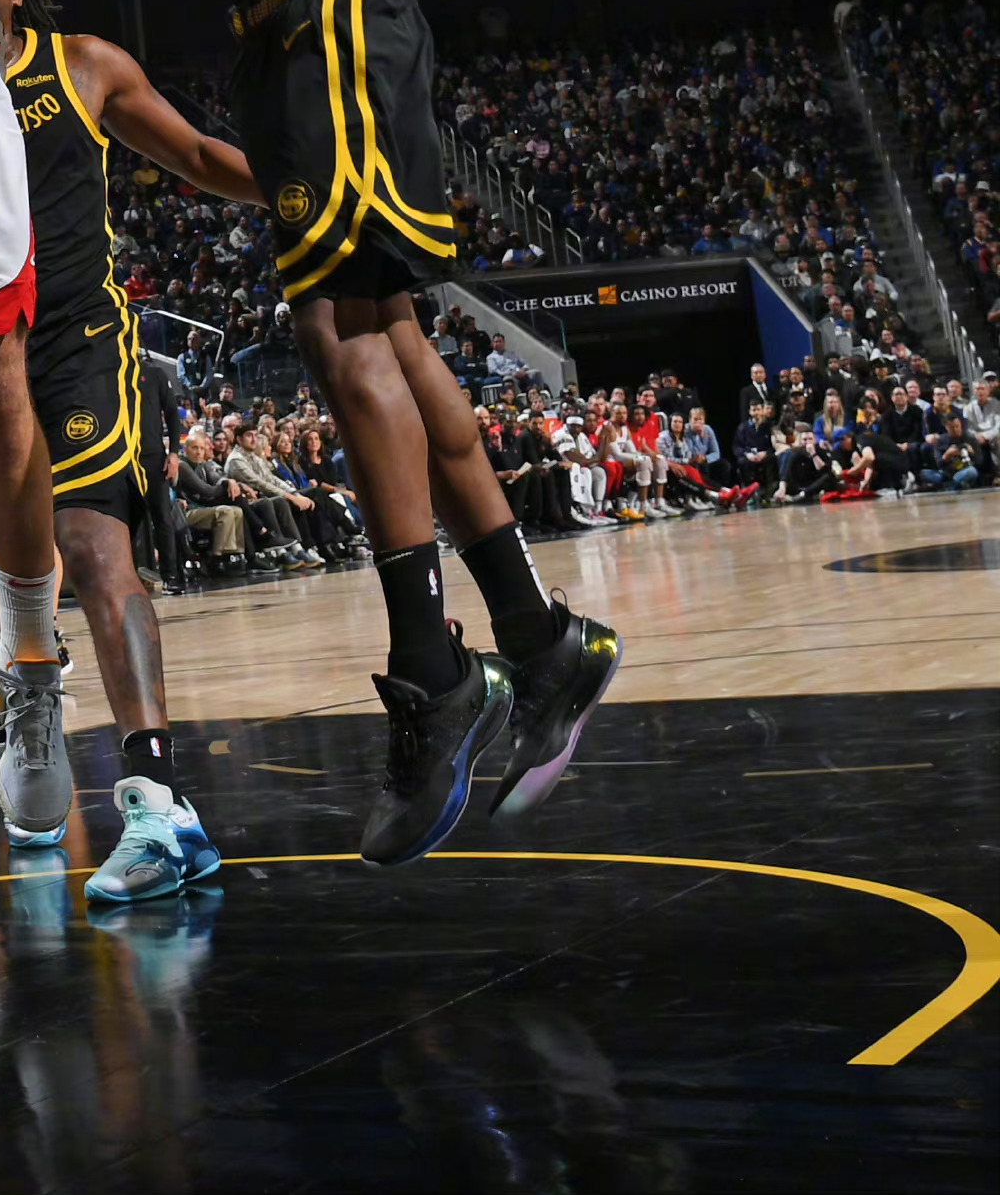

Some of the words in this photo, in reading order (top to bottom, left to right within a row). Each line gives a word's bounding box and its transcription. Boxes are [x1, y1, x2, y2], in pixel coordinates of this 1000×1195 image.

[16, 74, 56, 88] Rakuten
[503, 299, 538, 313] CHE
[541, 293, 595, 309] CREEK
[620, 285, 678, 302] CASINO
[681, 281, 738, 297] RESORT
